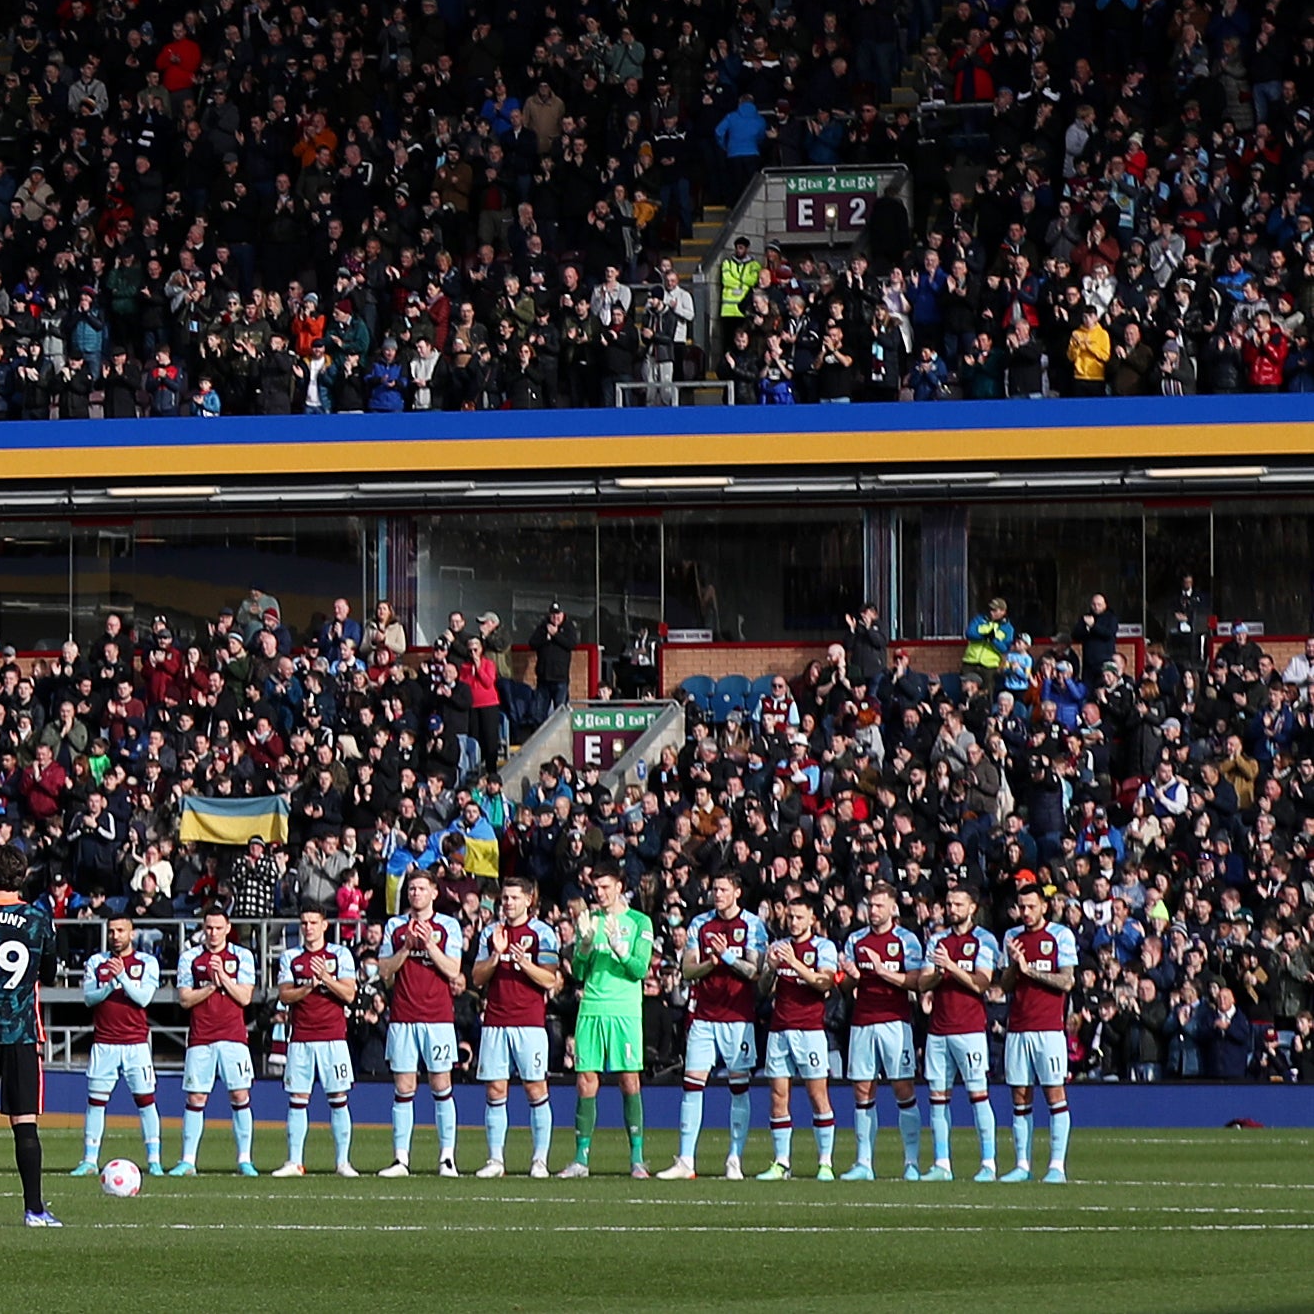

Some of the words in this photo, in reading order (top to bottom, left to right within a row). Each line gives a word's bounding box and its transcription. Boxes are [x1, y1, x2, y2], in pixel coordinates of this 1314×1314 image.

[828, 178, 836, 191] 2
[798, 198, 814, 226] E
[850, 198, 866, 226] 2
[616, 714, 624, 728] 8
[584, 735, 602, 764] E
[432, 1044, 451, 1062] 22
[624, 1042, 632, 1059] 1
[740, 1041, 749, 1056] 9
[534, 1052, 542, 1068] 5
[808, 1051, 820, 1068] 8
[902, 1050, 910, 1066] 3
[966, 1052, 982, 1068] 19
[1049, 1056, 1060, 1073] 11
[236, 1061, 250, 1078] 14
[334, 1063, 348, 1080] 18
